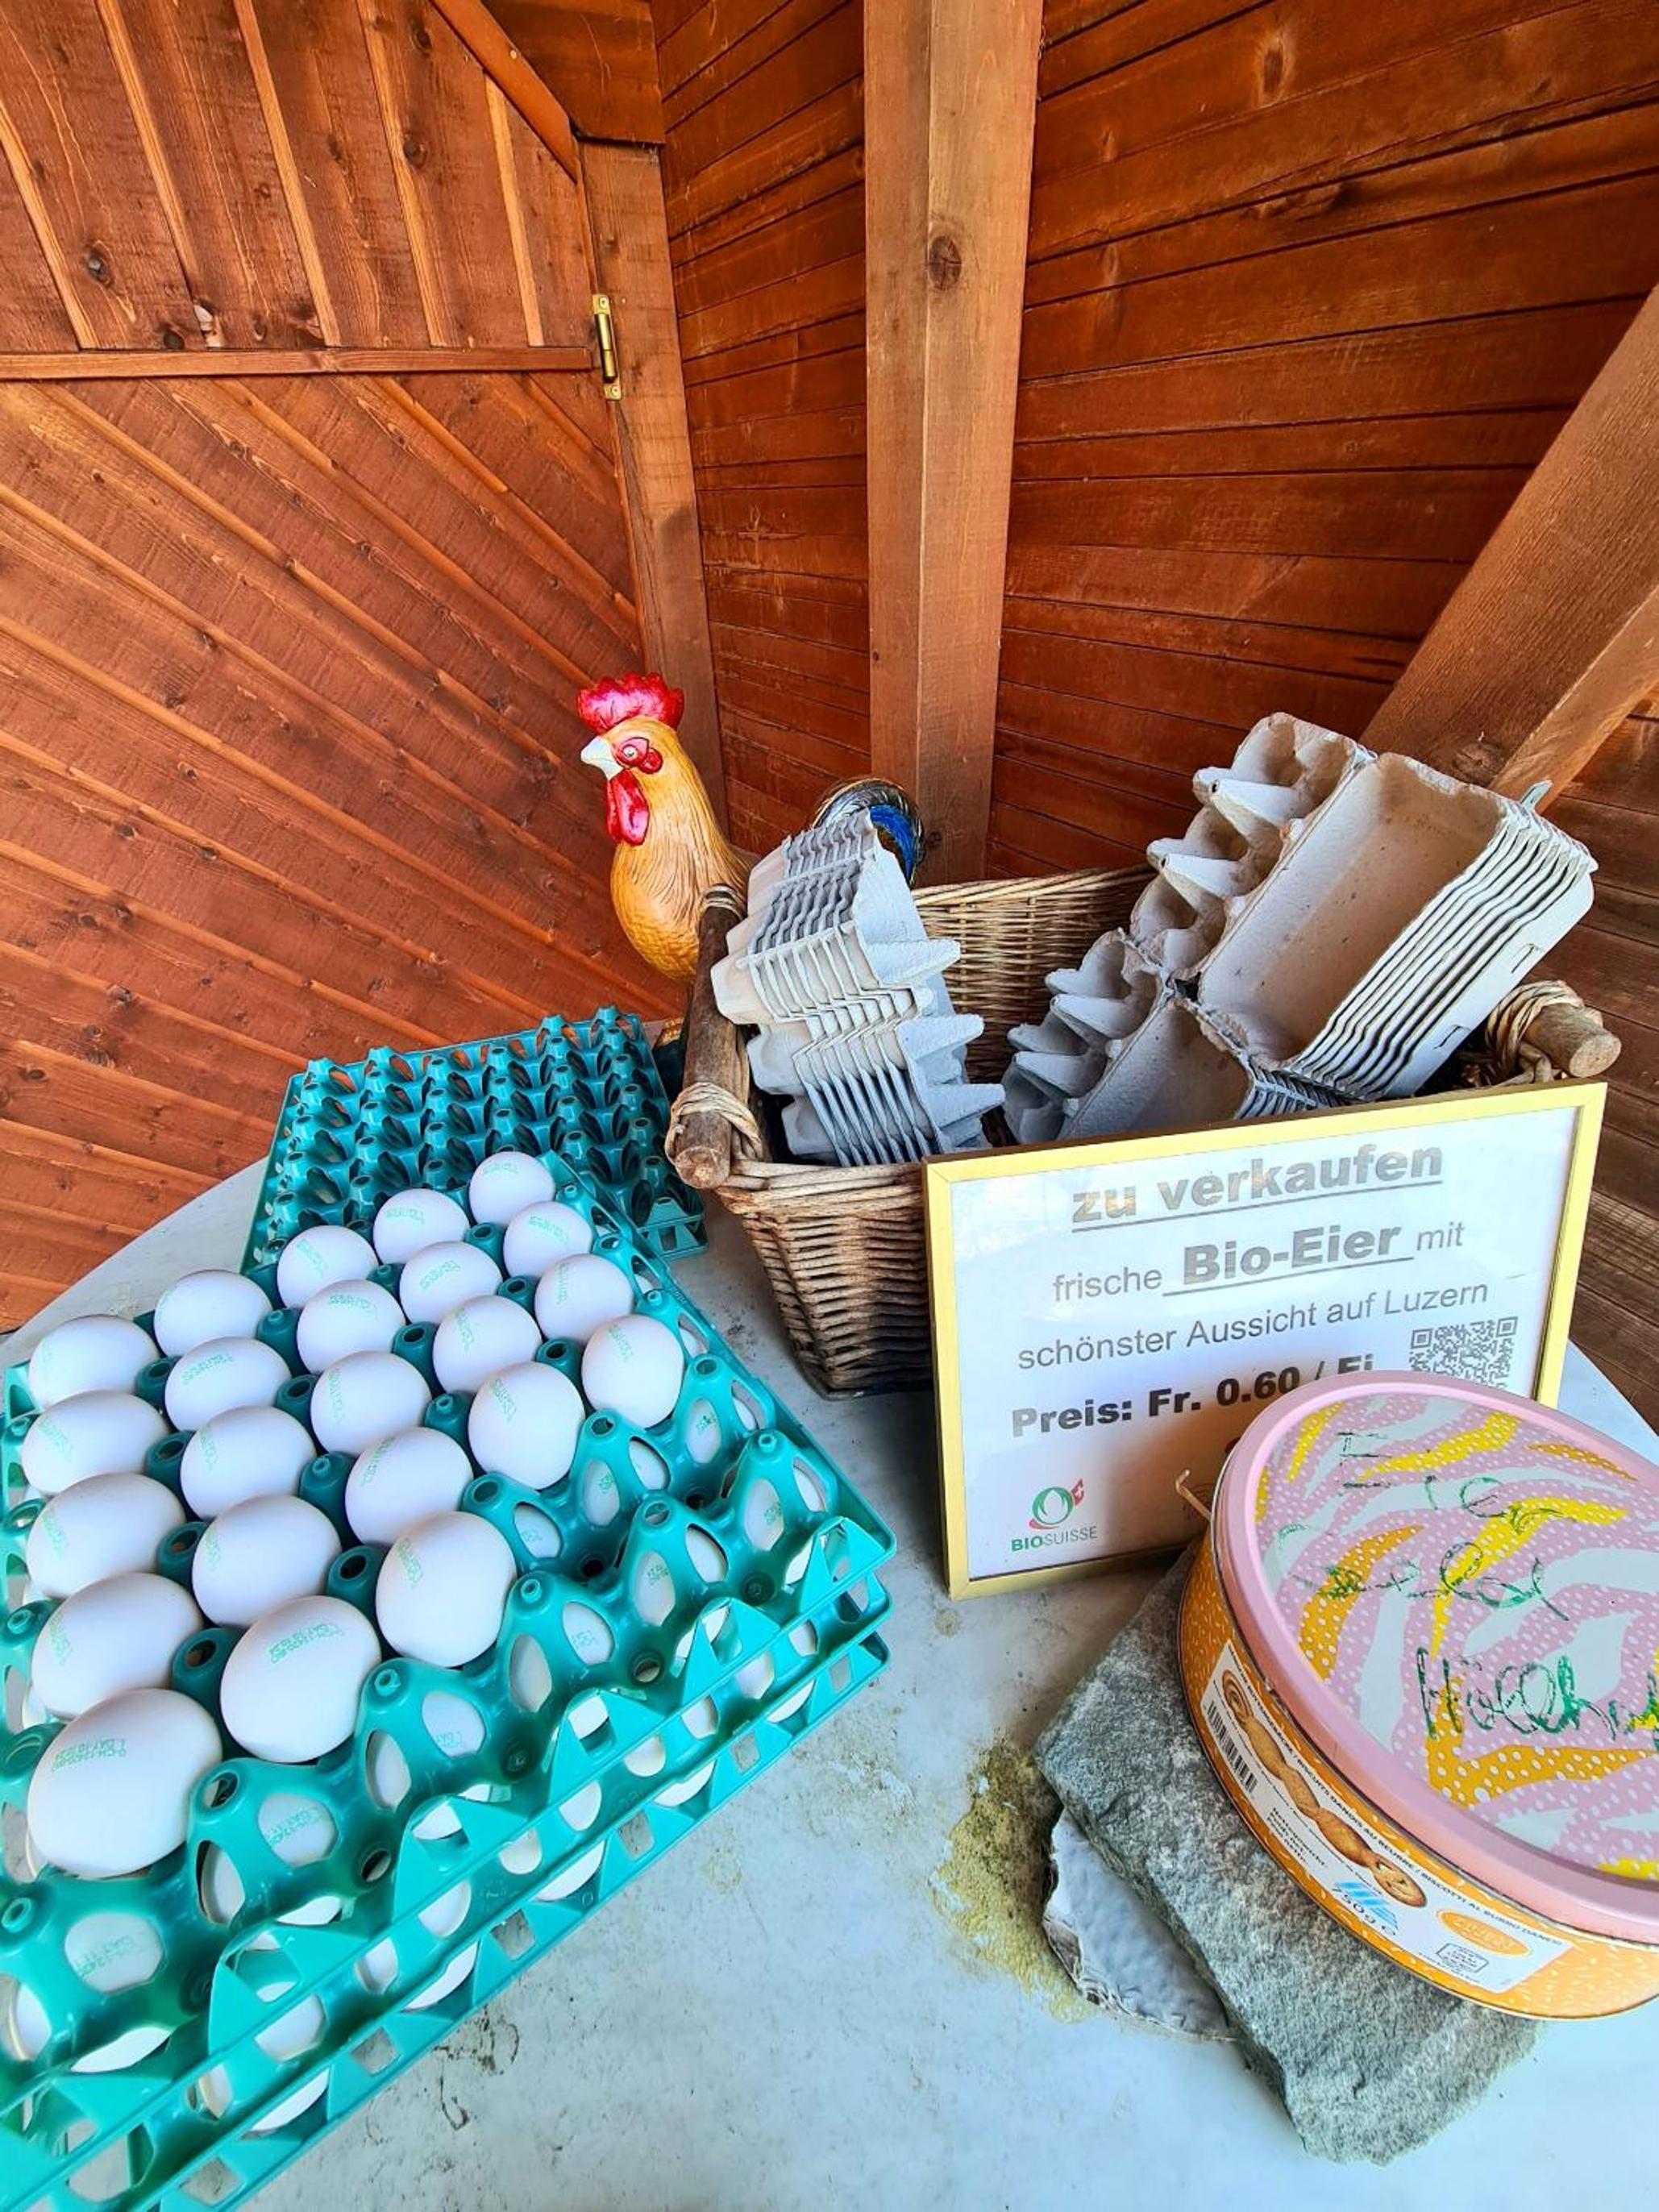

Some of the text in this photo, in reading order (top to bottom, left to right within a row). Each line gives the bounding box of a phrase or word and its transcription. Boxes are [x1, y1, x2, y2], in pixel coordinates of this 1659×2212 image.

[1072, 1144, 1443, 1223] zu verkaufen
[1053, 1221, 1465, 1301] frische Bio-Eier mit
[1018, 1283, 1488, 1370] schönster Aussicht auf Luzern
[1012, 1399, 1132, 1437] Preis:
[1149, 1387, 1201, 1416] Fr.
[1216, 1366, 1300, 1406] 0.60
